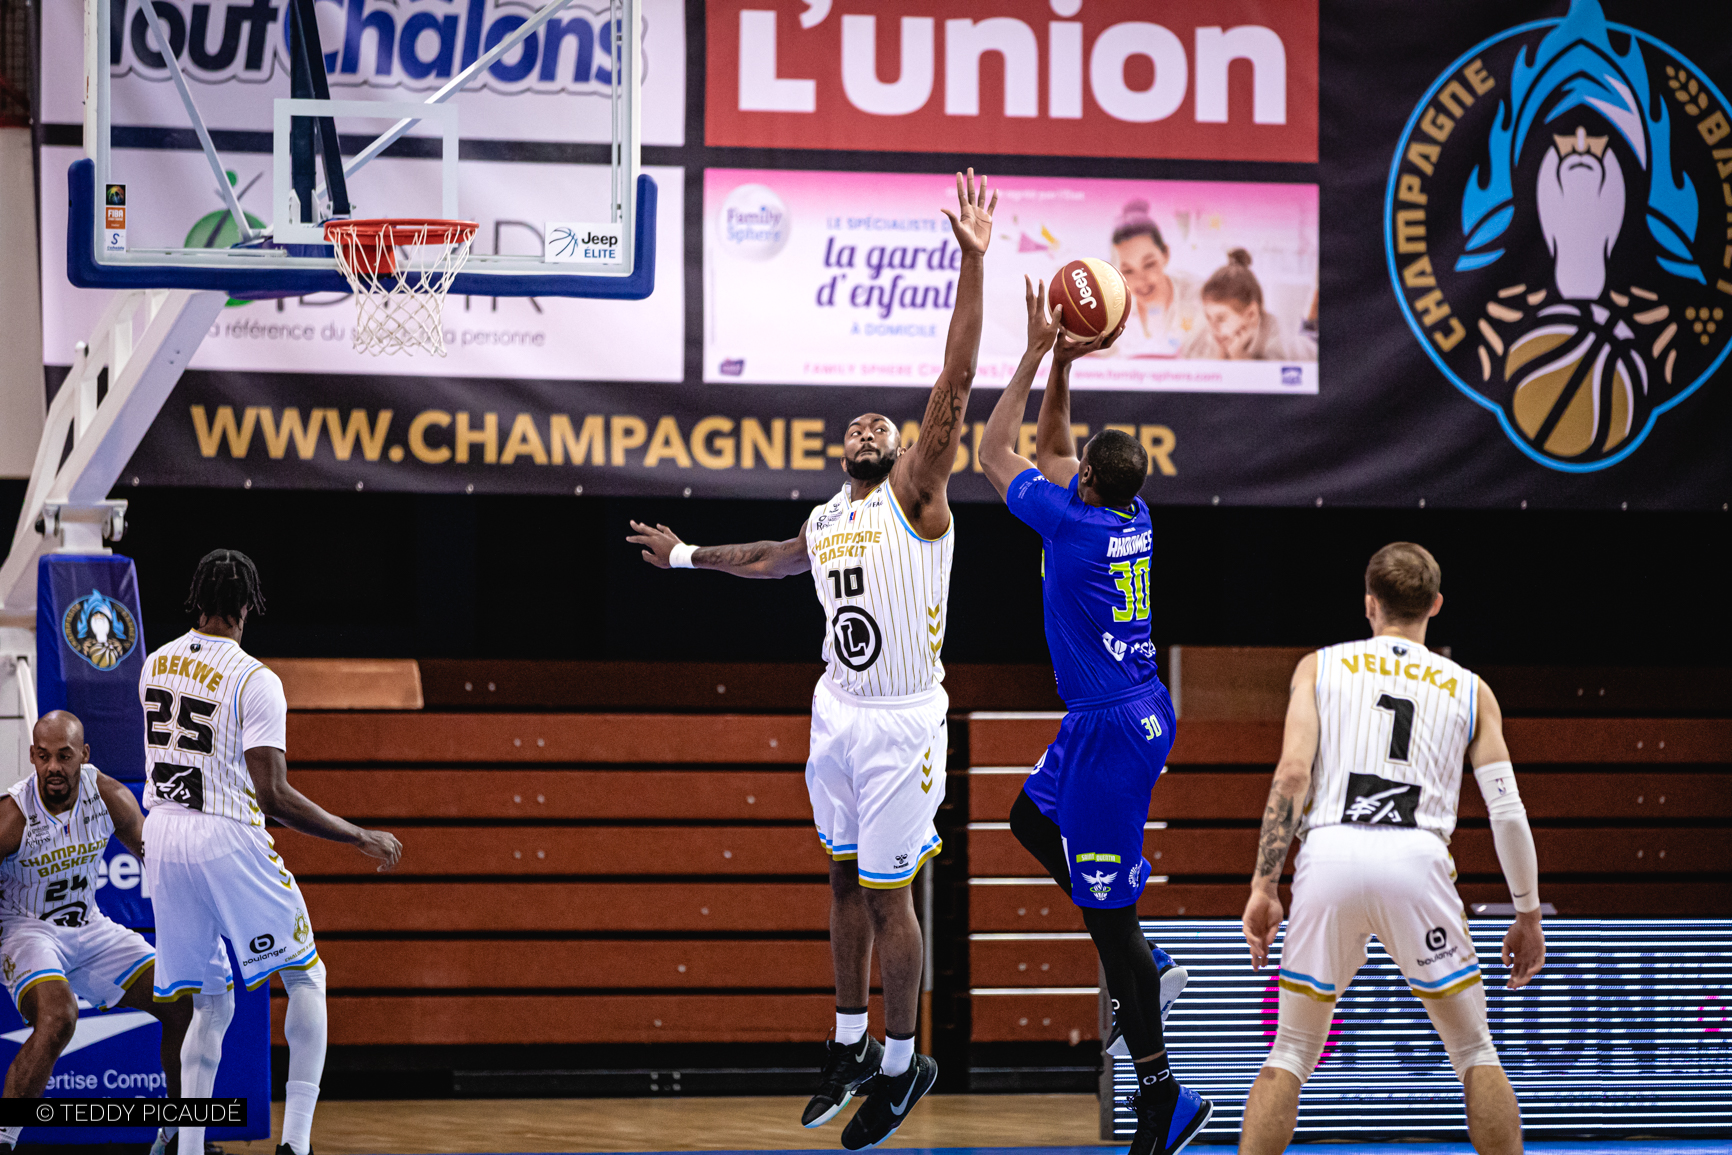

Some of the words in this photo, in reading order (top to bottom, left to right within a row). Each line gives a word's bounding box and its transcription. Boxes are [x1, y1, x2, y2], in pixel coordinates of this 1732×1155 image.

[738, 0, 1287, 125] L'union
[108, 209, 124, 218] FIBA
[1396, 58, 1496, 353] CHAMPAGNE
[581, 231, 618, 248] Jeep
[584, 246, 616, 259] ÉLITE
[824, 236, 857, 269] la
[1071, 268, 1097, 309] Jeep
[225, 320, 315, 340] référence
[320, 320, 346, 341] du
[461, 331, 546, 347] personne
[827, 566, 865, 600] 10
[1108, 556, 1150, 622] 30
[151, 655, 223, 692] IBEKWE
[1341, 653, 1458, 698] VELICKA
[144, 684, 222, 757] 25
[1140, 714, 1163, 741] 30
[1371, 690, 1418, 766] 1
[37, 853, 98, 878] BASKET
[45, 874, 88, 902] 24
[242, 946, 287, 966] boulanger
